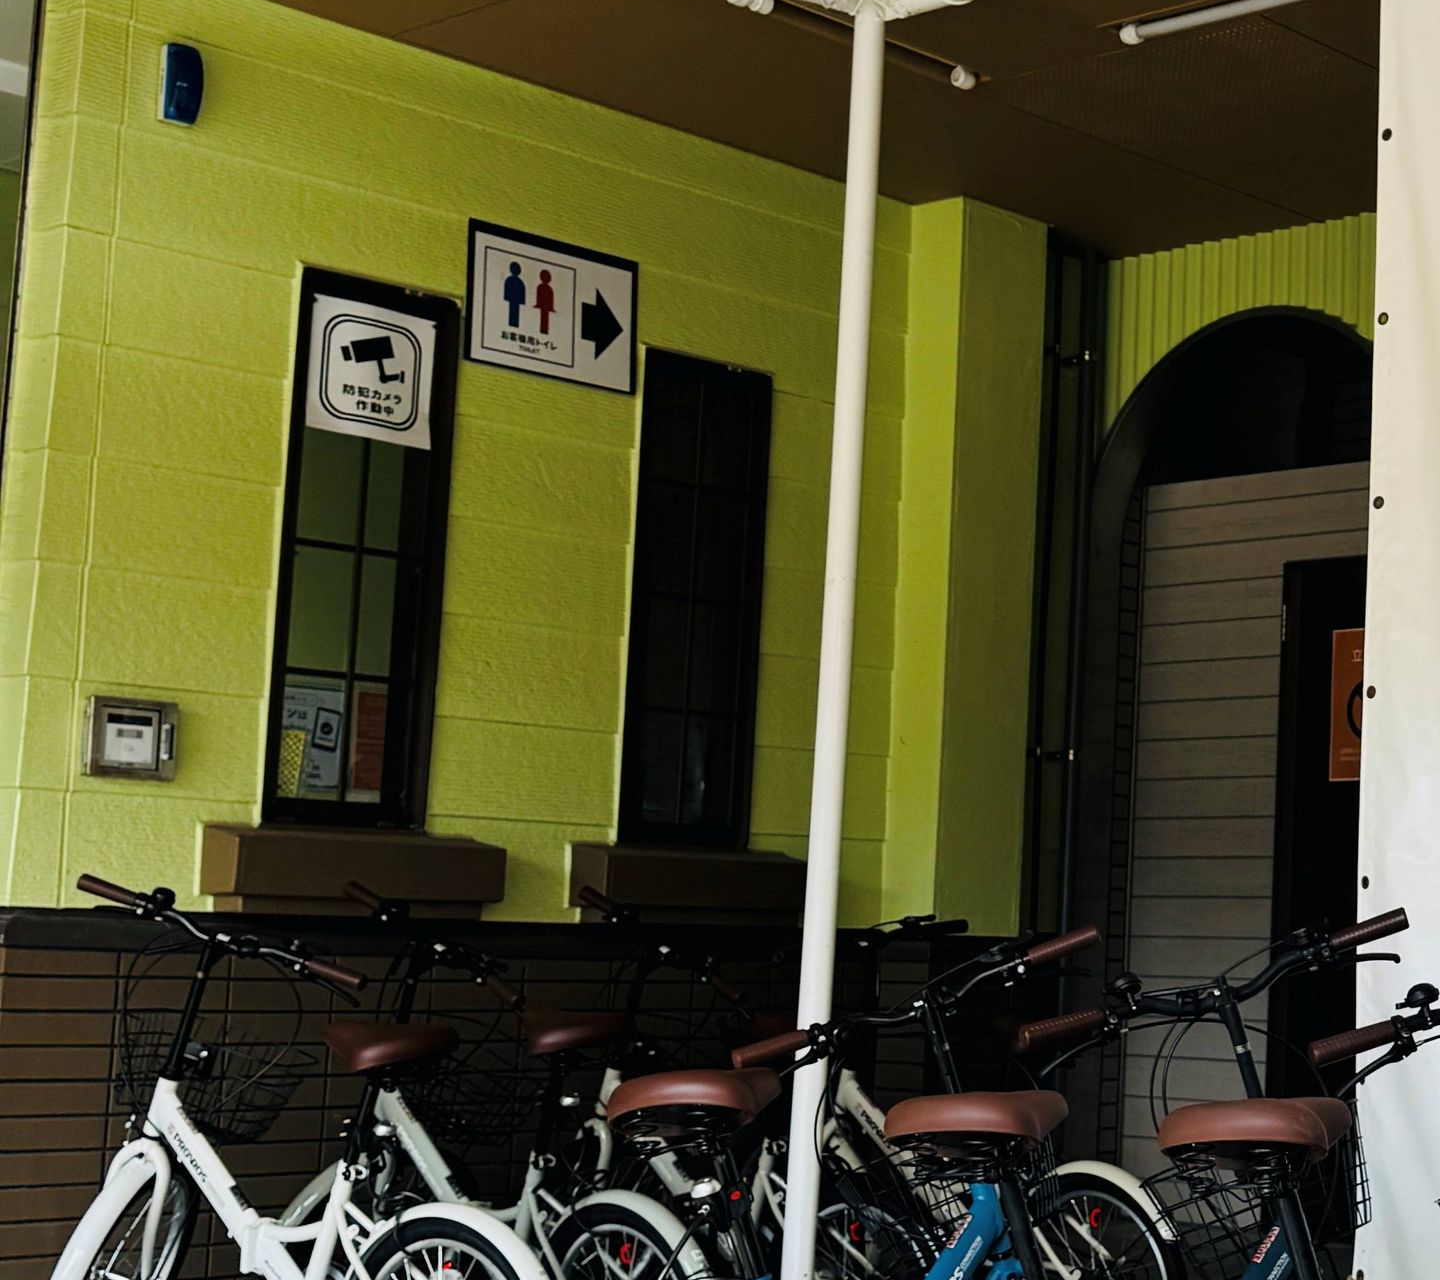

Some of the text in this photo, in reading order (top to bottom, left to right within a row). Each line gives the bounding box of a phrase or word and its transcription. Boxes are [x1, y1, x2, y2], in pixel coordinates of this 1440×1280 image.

[342, 383, 402, 405] 防犯カメラ
[355, 400, 395, 417] 作動中
